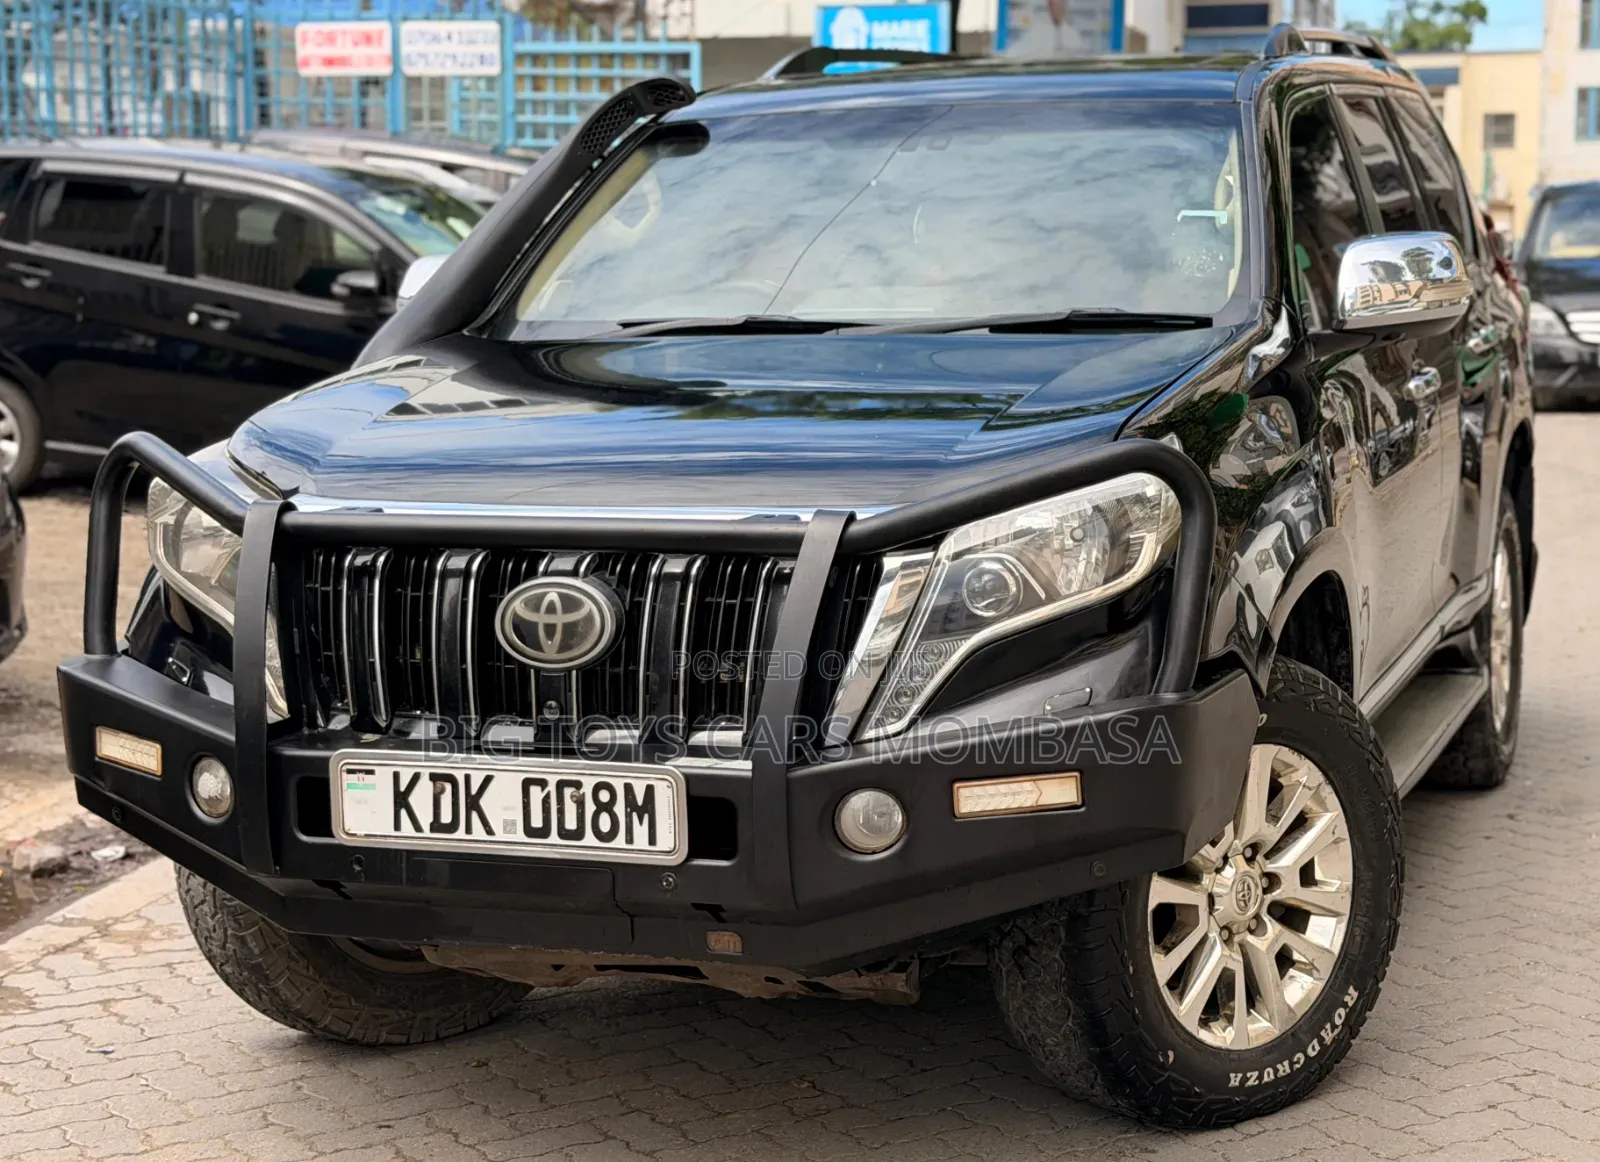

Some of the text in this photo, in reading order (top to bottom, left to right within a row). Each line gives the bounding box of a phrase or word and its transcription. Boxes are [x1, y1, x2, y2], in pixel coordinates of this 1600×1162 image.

[392, 769, 496, 837] KDK
[521, 776, 658, 847] 008M
[1228, 984, 1360, 1088] ROADCRUZA
